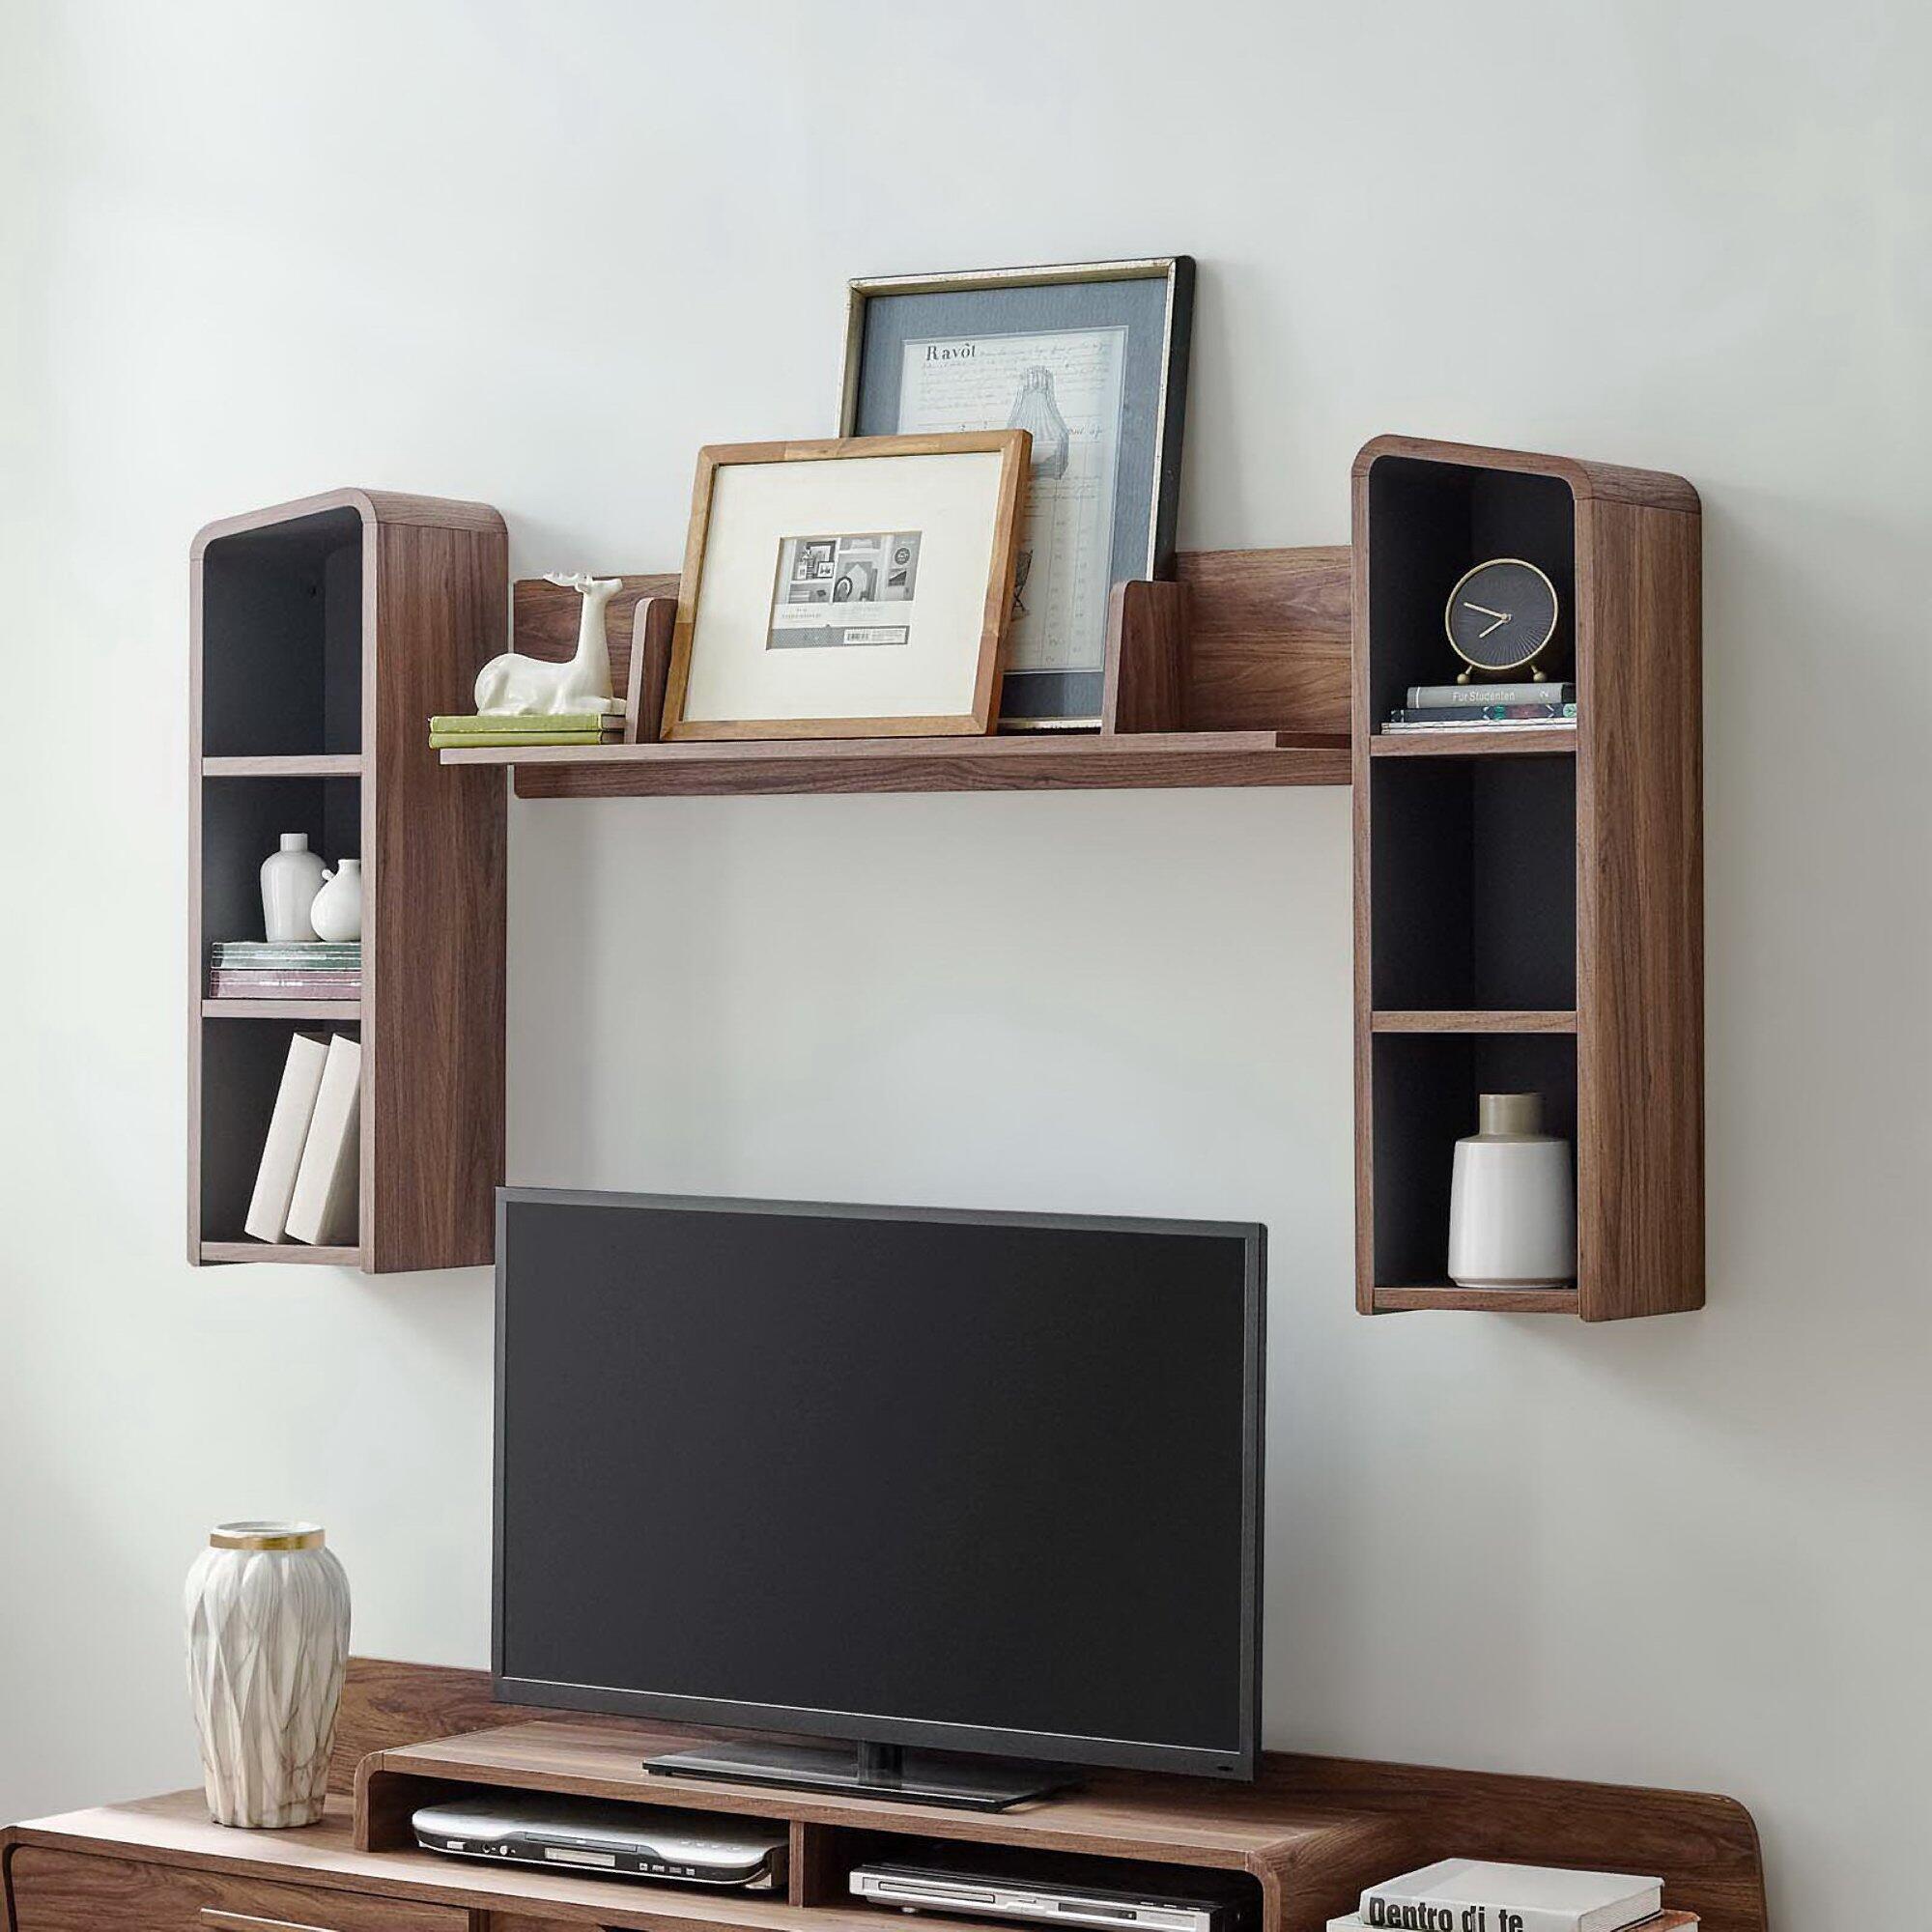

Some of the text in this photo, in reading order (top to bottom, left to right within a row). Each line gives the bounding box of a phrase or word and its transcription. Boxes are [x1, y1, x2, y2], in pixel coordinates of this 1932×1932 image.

[1369, 1896, 1523, 1932] Dentro di te
